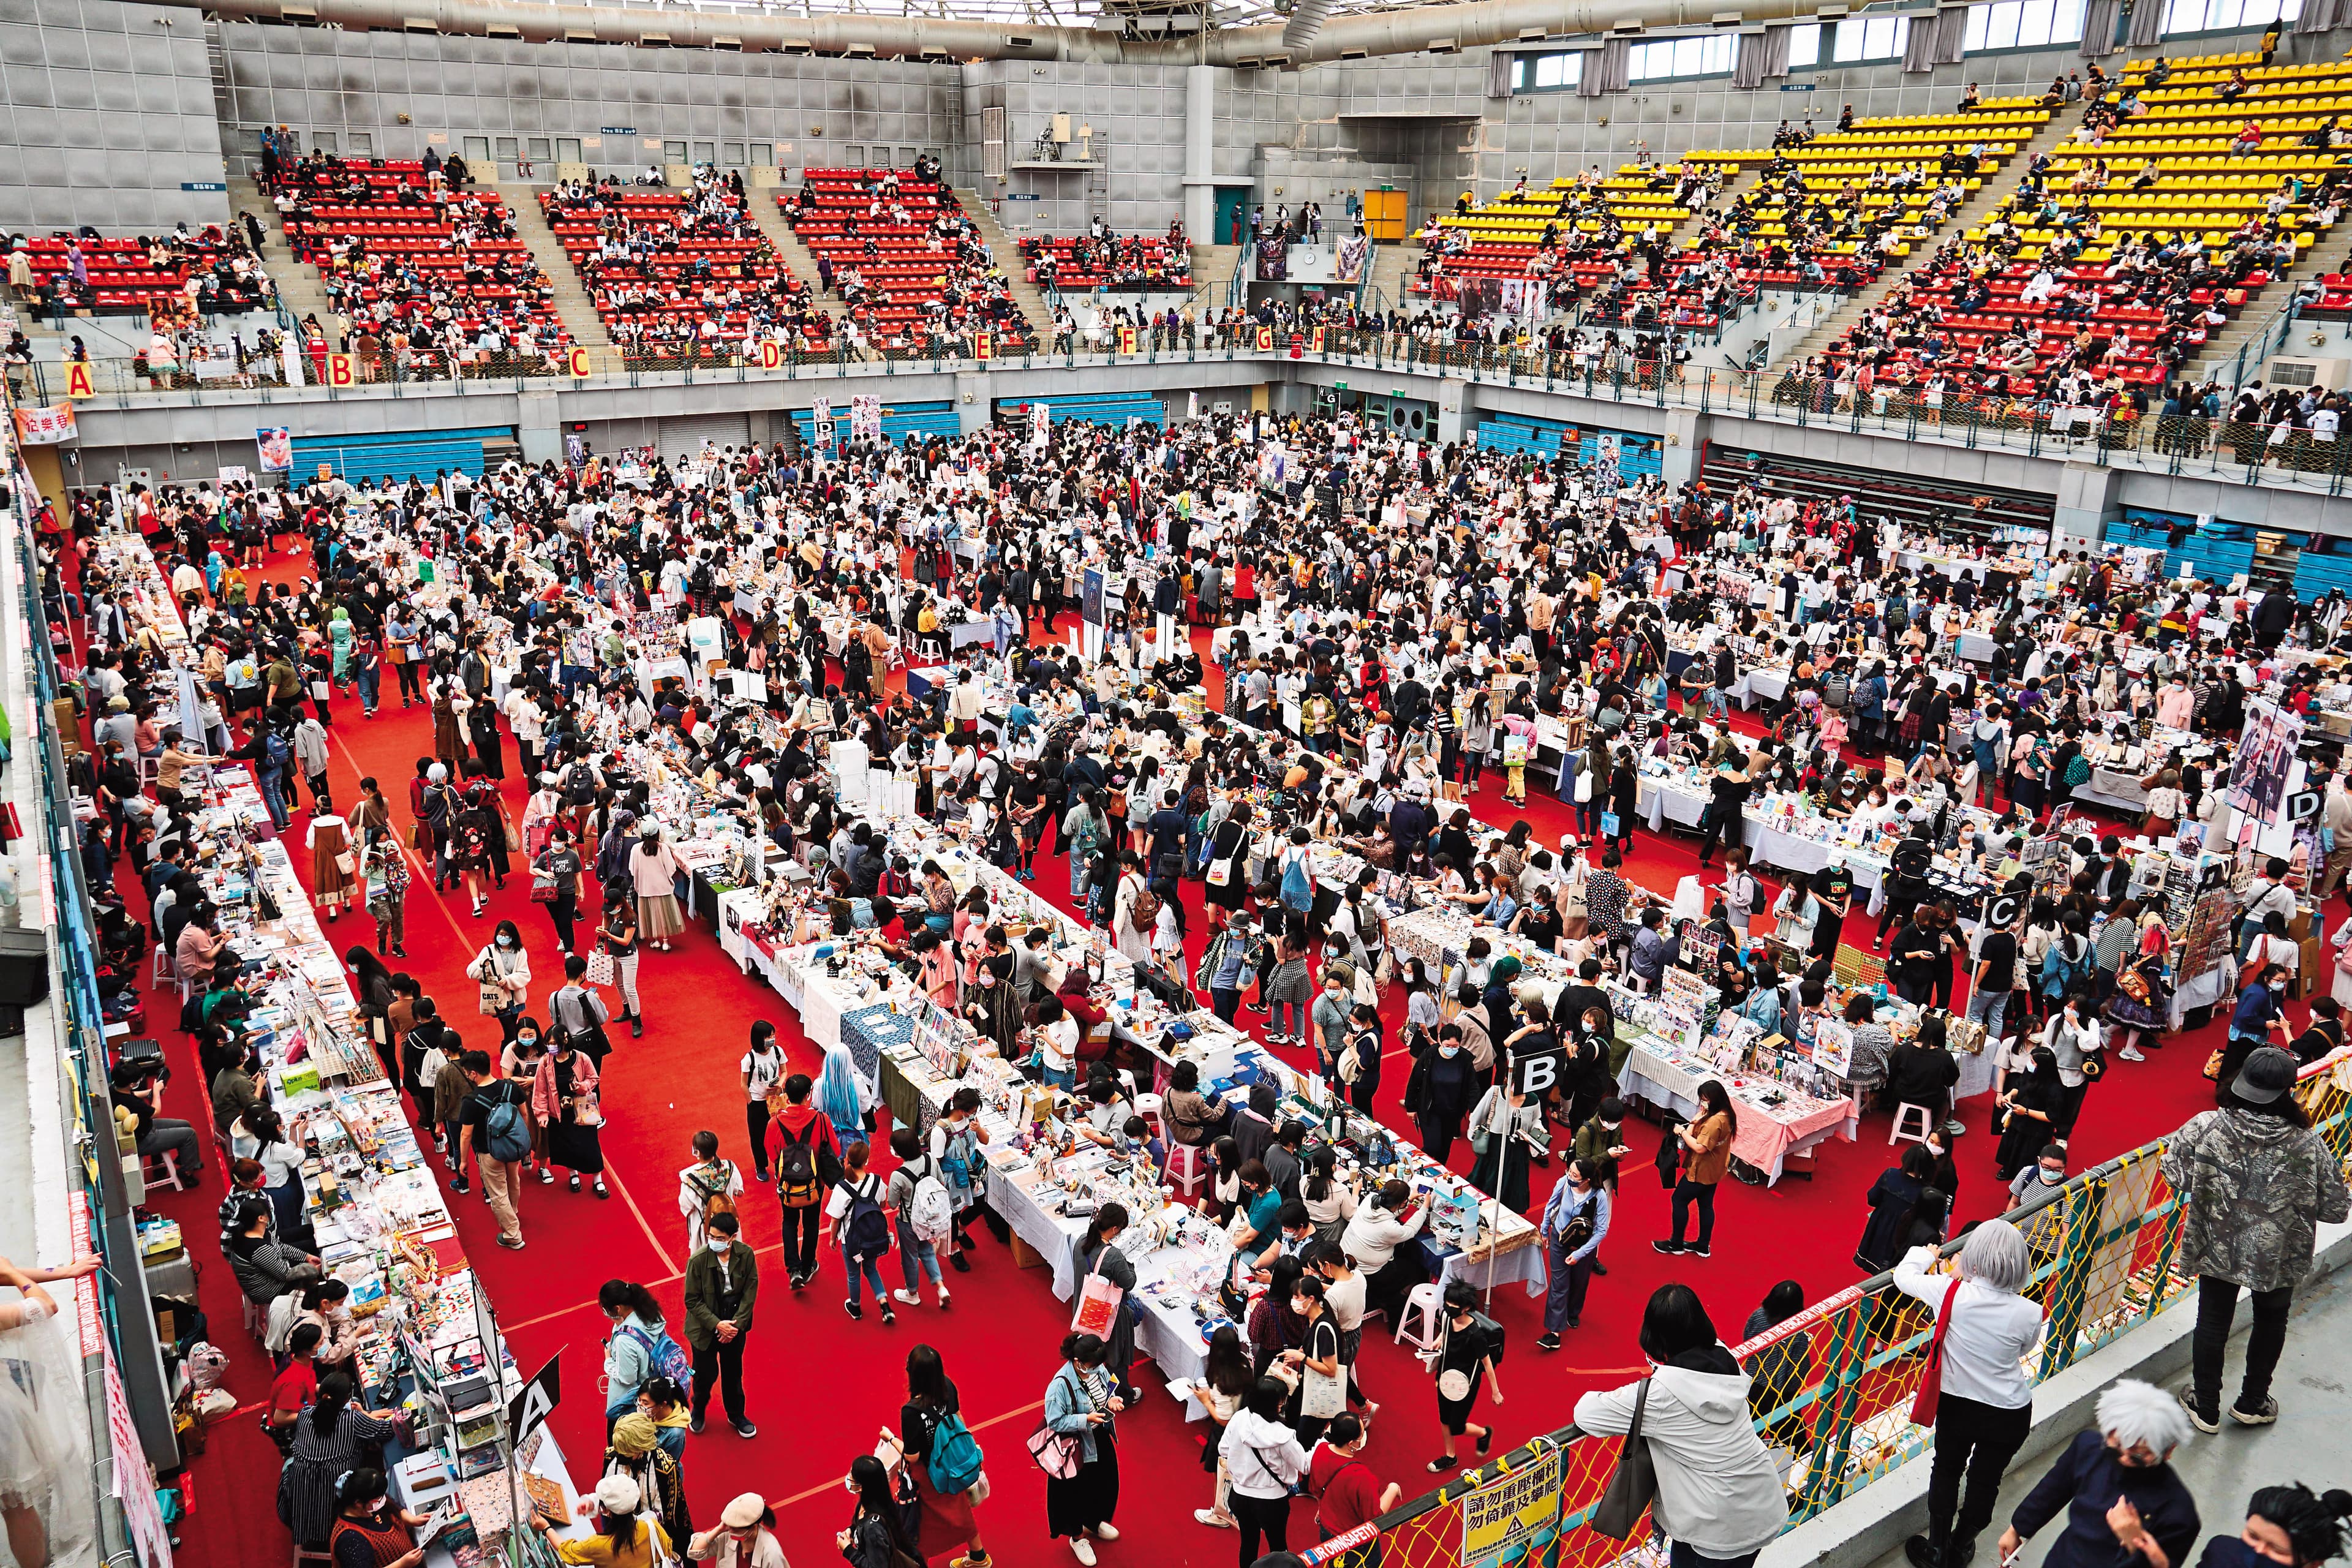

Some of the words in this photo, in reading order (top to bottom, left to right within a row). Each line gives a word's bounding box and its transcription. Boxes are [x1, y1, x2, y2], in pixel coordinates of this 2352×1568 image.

[977, 335, 989, 360] E
[1123, 331, 1133, 353] F
[1257, 327, 1271, 349] G
[1313, 328, 1324, 351] H
[571, 349, 589, 376] C
[763, 342, 778, 368] D
[70, 365, 92, 395] A
[332, 356, 351, 385] B
[1327, 394, 1336, 403] G
[819, 423, 832, 432] D
[2294, 793, 2319, 819] D
[1992, 898, 2015, 925] C
[757, 1061, 778, 1081] NY
[1523, 1056, 1556, 1093] B
[1747, 1335, 1766, 1351] CLIMB
[1763, 1329, 1776, 1342] ON
[1772, 1324, 1785, 1337] THE
[1781, 1314, 1803, 1333] FENCE
[1800, 1308, 1813, 1322] FOR
[1809, 1301, 1828, 1317] YOUR
[1825, 1294, 1841, 1310] OWN
[518, 1379, 553, 1440] A
[1468, 1458, 1558, 1515] 請勿重壓欄杆
[1468, 1476, 1557, 1531] 勿倚靠及攀爬
[1300, 1546, 1330, 1566] YUR
[1324, 1537, 1346, 1556] OWN
